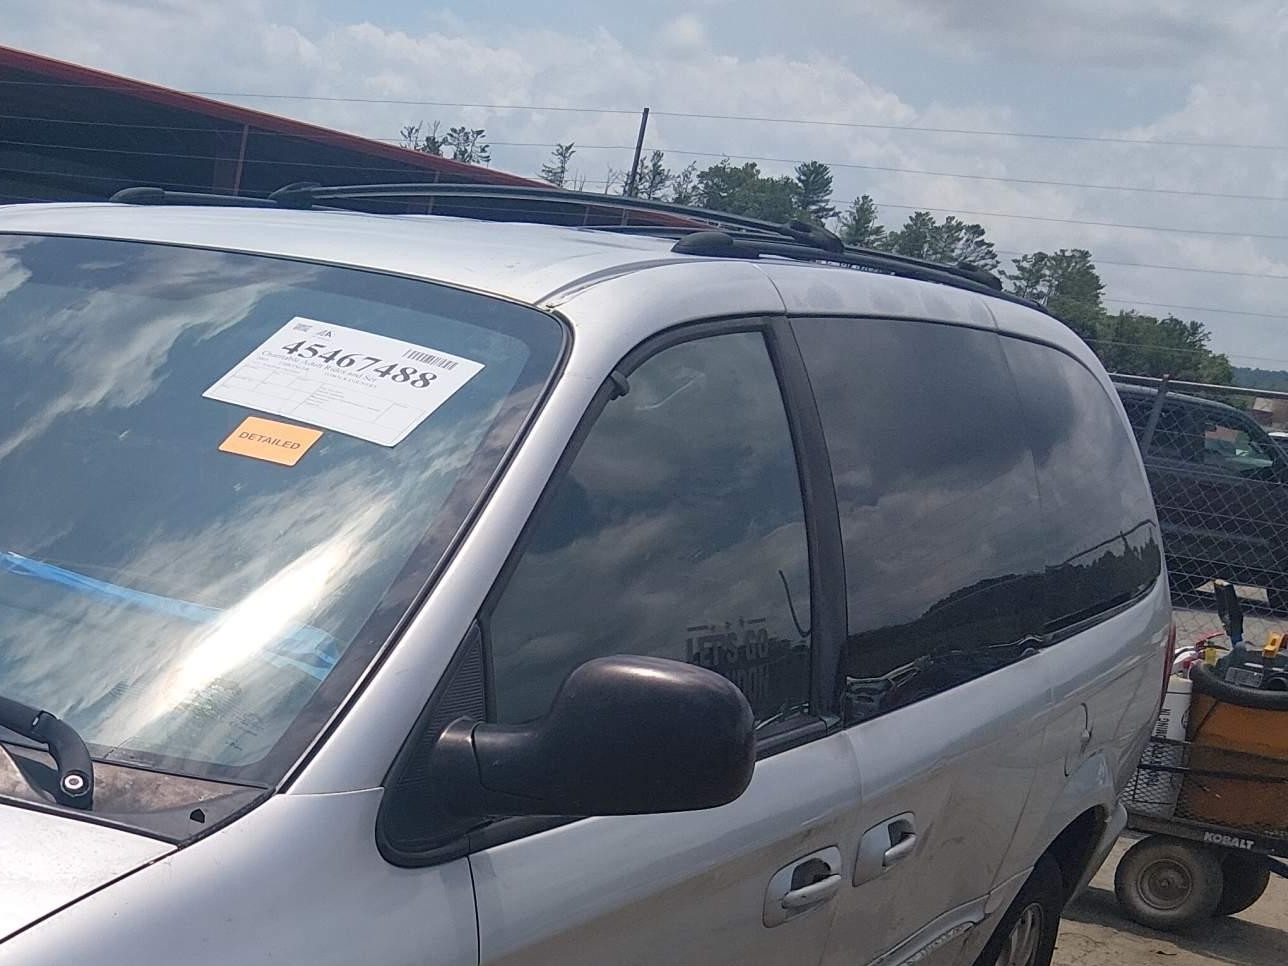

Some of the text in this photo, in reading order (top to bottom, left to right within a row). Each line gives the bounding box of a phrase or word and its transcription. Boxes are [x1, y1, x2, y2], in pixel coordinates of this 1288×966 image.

[281, 340, 438, 390] 45467488
[238, 430, 301, 451] DETAILED
[1203, 831, 1255, 850] KOBALT
